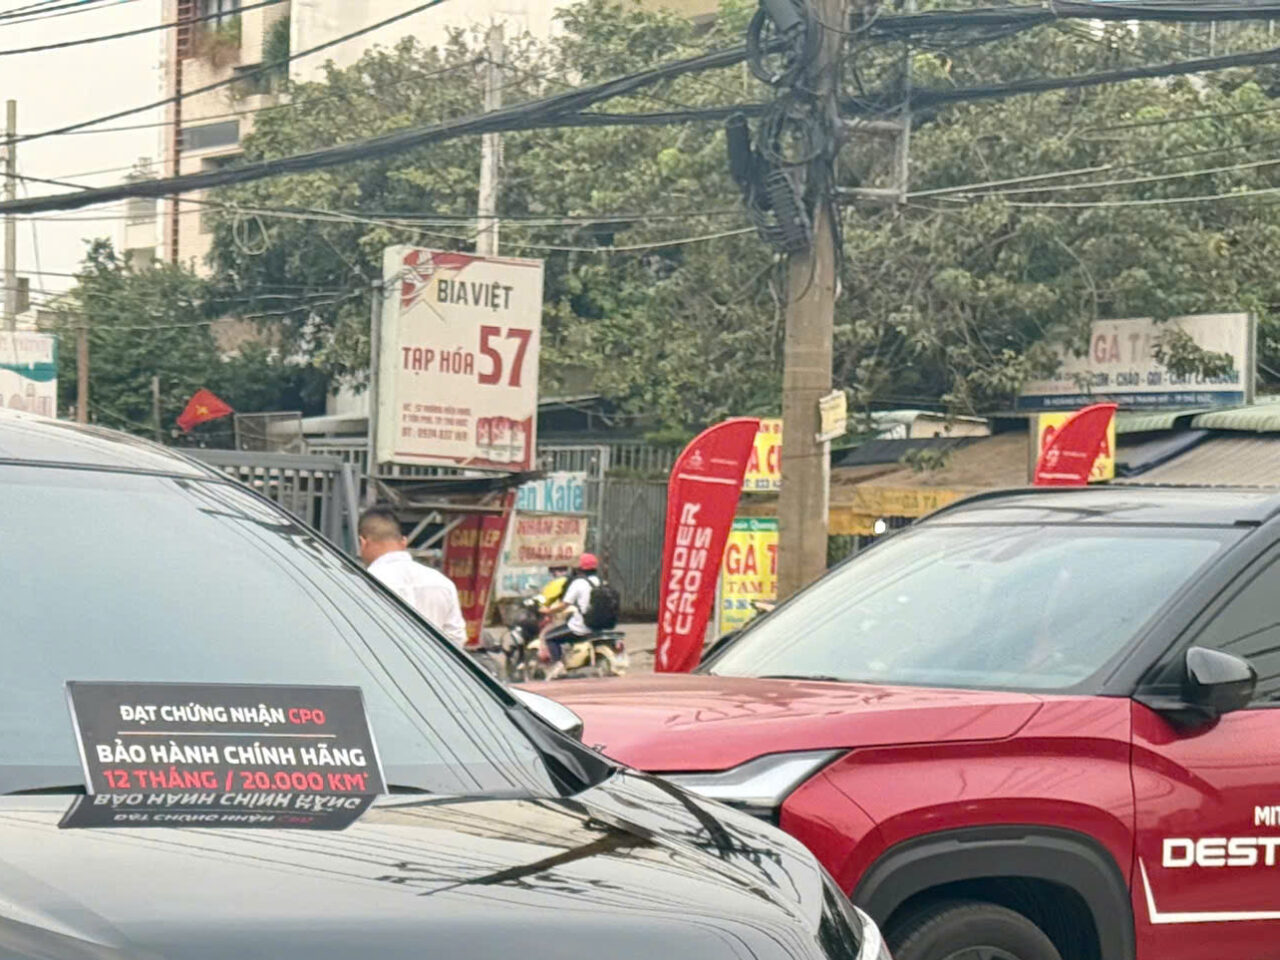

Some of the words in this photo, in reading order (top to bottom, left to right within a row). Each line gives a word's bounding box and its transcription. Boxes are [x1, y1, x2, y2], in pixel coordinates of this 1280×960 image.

[437, 279, 468, 306] BIA
[470, 281, 514, 312] VIỆT
[401, 346, 435, 376] TẠP
[439, 347, 474, 376] HÓA
[477, 324, 533, 388] 57
[1094, 326, 1119, 364] GÀ
[726, 534, 758, 575] GÀ
[675, 527, 713, 635] CROSS
[728, 581, 763, 594] TAM
[120, 705, 156, 725] ĐẠT
[161, 703, 227, 723] CHỨNG
[231, 707, 285, 727] NHẬN
[289, 708, 325, 724] CPO
[96, 739, 145, 764] BẢO
[150, 742, 219, 764] HÀNH
[224, 742, 296, 765] CHÍNH
[300, 744, 366, 766] HÃNG
[104, 770, 130, 789] 12
[133, 767, 218, 789] THÁNG
[225, 770, 233, 791] /
[240, 772, 323, 791] 20.000
[1162, 837, 1280, 868] DEST
